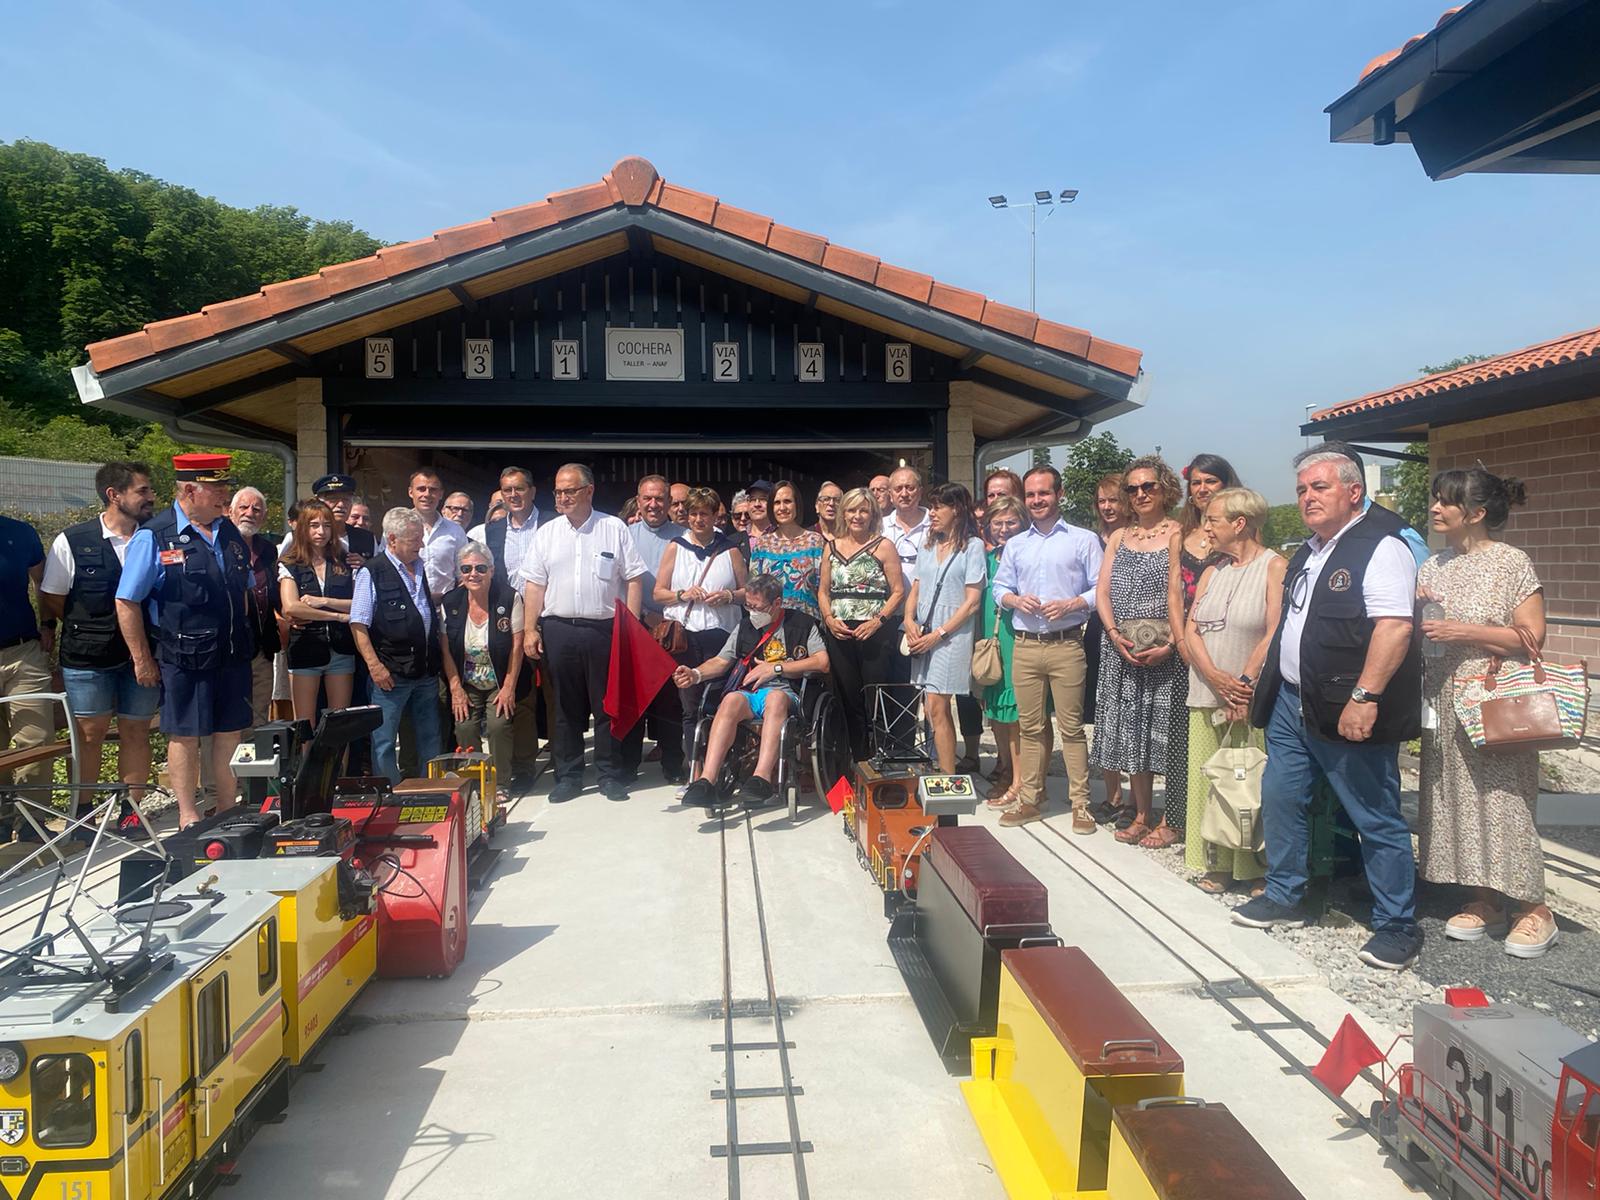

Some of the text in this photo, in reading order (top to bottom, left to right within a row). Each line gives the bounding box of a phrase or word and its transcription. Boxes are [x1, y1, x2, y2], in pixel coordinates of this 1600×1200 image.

[369, 343, 390, 353] VIA
[469, 344, 490, 354] VIA
[555, 345, 576, 355] VIA
[617, 342, 672, 355] COCHERA
[716, 347, 736, 357] VIA
[802, 348, 821, 358] VIA
[889, 348, 908, 358] VIA
[373, 355, 386, 373] 5
[473, 356, 486, 374] 3
[560, 357, 571, 375] 1
[720, 359, 733, 377] 2
[805, 360, 818, 377] 4
[892, 360, 904, 377] 6
[61, 1181, 93, 1200] 151
